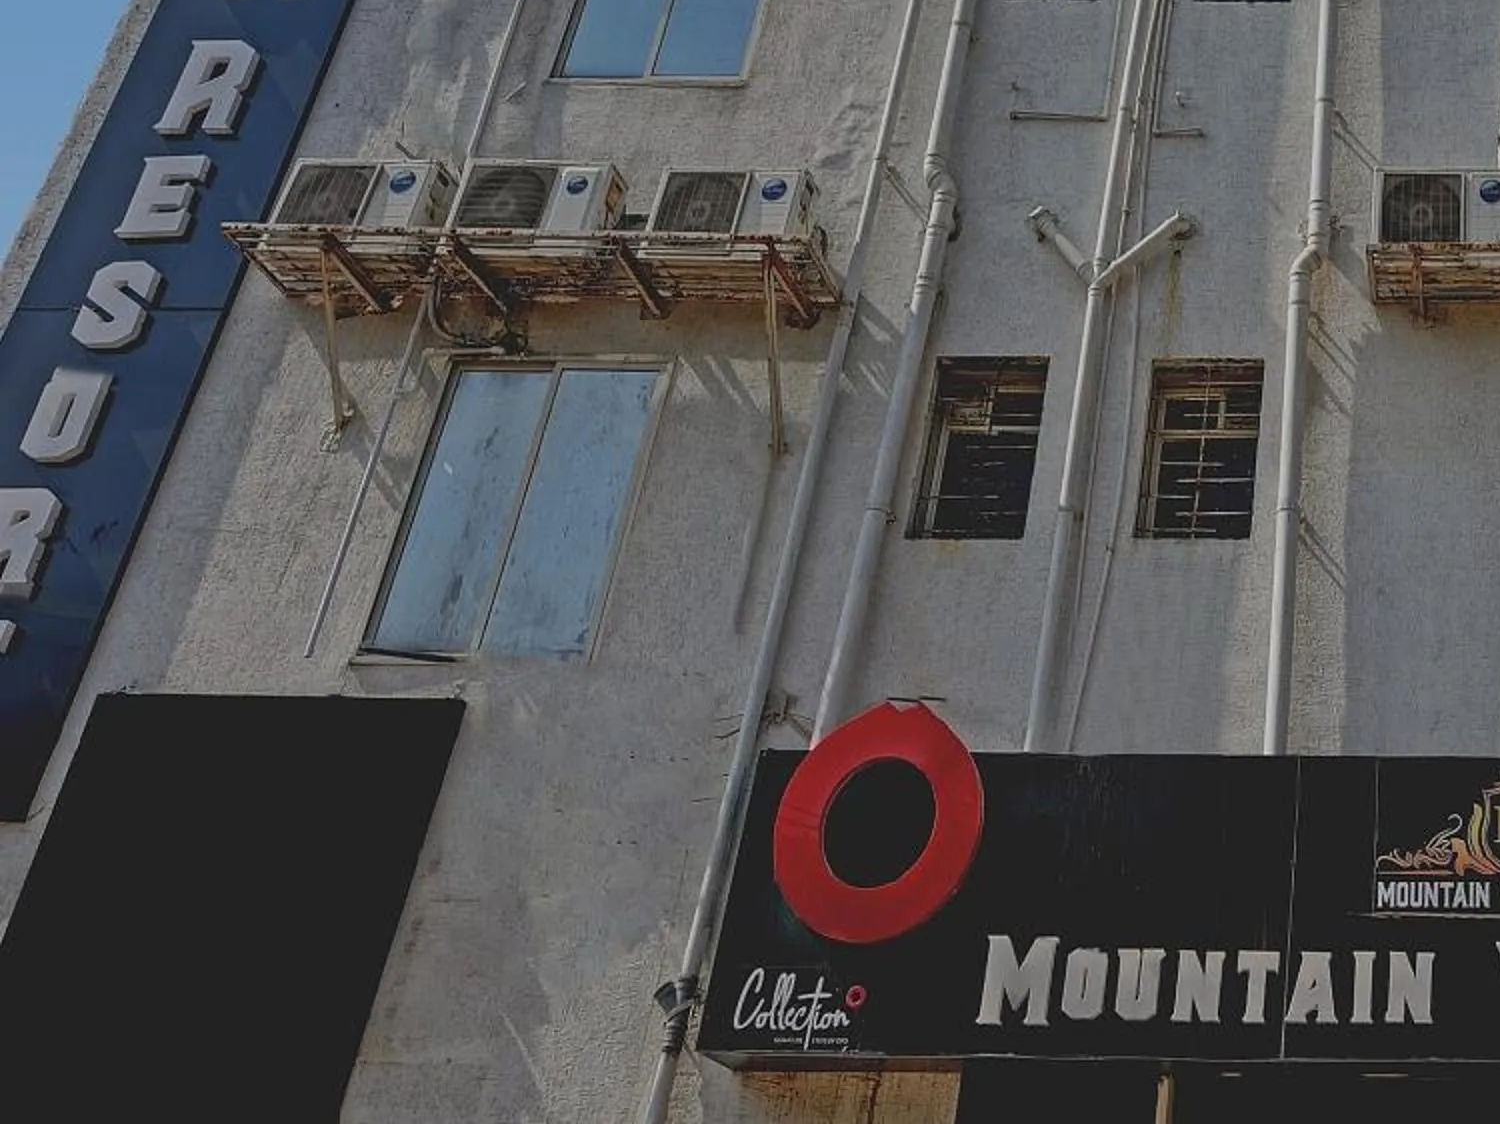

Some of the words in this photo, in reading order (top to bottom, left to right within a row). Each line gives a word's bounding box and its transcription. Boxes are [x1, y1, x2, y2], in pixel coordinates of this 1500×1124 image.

[0, 38, 262, 656] RESOR
[1376, 881, 1491, 909] MOUNTAIN
[733, 966, 850, 1051] Collection
